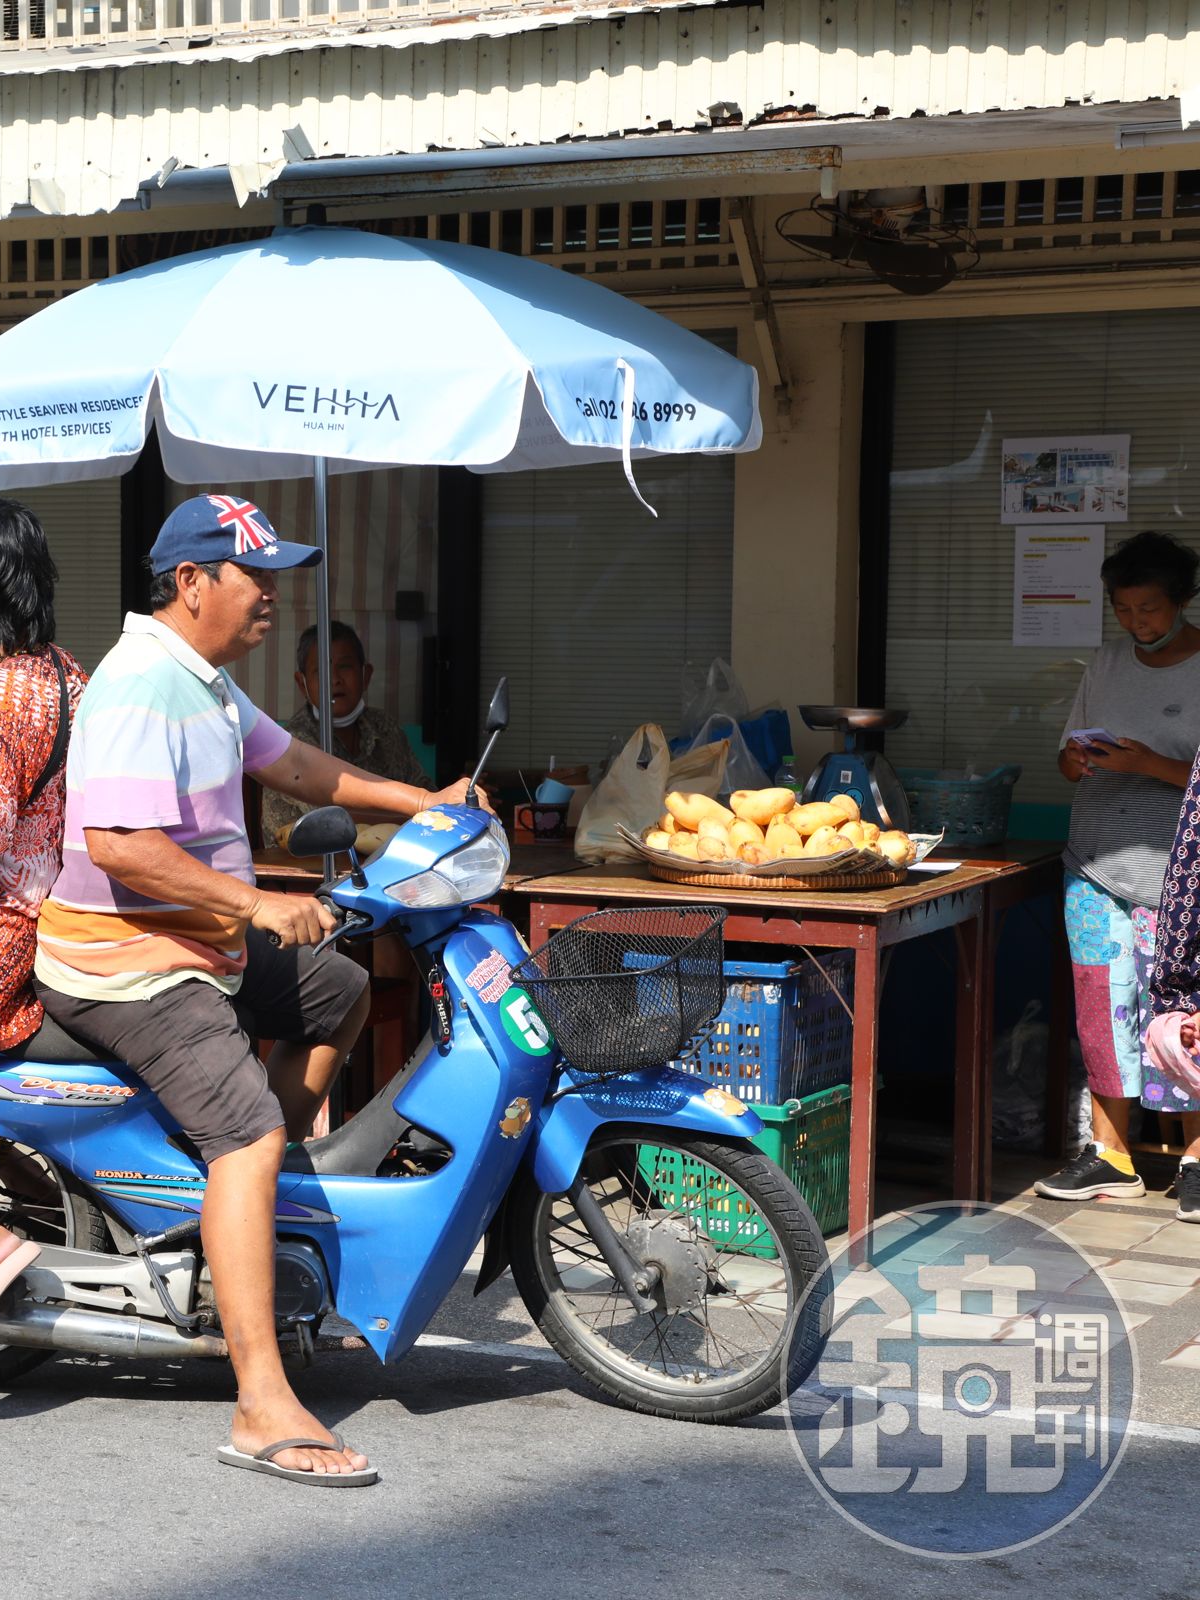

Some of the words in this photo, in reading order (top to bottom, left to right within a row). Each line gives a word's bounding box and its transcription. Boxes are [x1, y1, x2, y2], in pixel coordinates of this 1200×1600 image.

[28, 402, 79, 419] SEAVIEW
[599, 399, 618, 420] 02
[653, 402, 697, 422] 8999
[303, 421, 324, 430] HUA
[327, 423, 345, 431] HIN
[21, 427, 59, 443] HOTEL
[19, 1075, 139, 1098] Dream
[94, 1169, 145, 1180] HONDA
[145, 1174, 195, 1183] Electric
